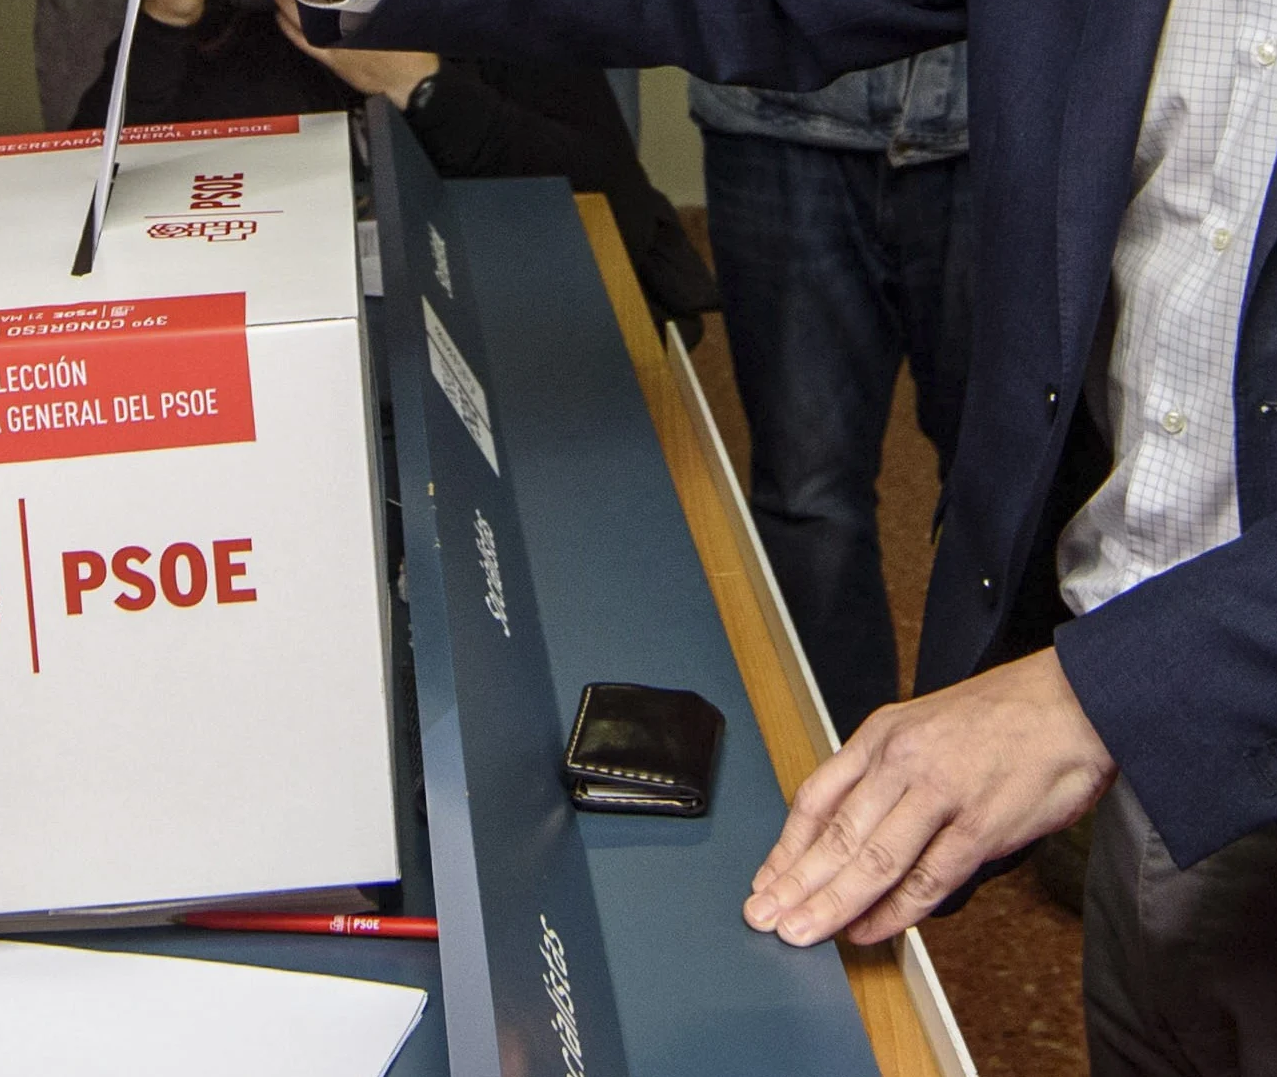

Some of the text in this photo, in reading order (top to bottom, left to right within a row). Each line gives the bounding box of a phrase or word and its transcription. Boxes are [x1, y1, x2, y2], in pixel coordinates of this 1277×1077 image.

[191, 128, 221, 138] DEL
[228, 124, 273, 133] PSOE
[190, 173, 244, 210] PSOE
[53, 309, 99, 320] PSOE
[7, 318, 125, 339] CONGRESO
[7, 397, 108, 433] GENERAL
[113, 394, 156, 423] DEL
[160, 388, 219, 418] PSOE
[62, 538, 257, 615] PSOE
[353, 918, 380, 930] PSOE
